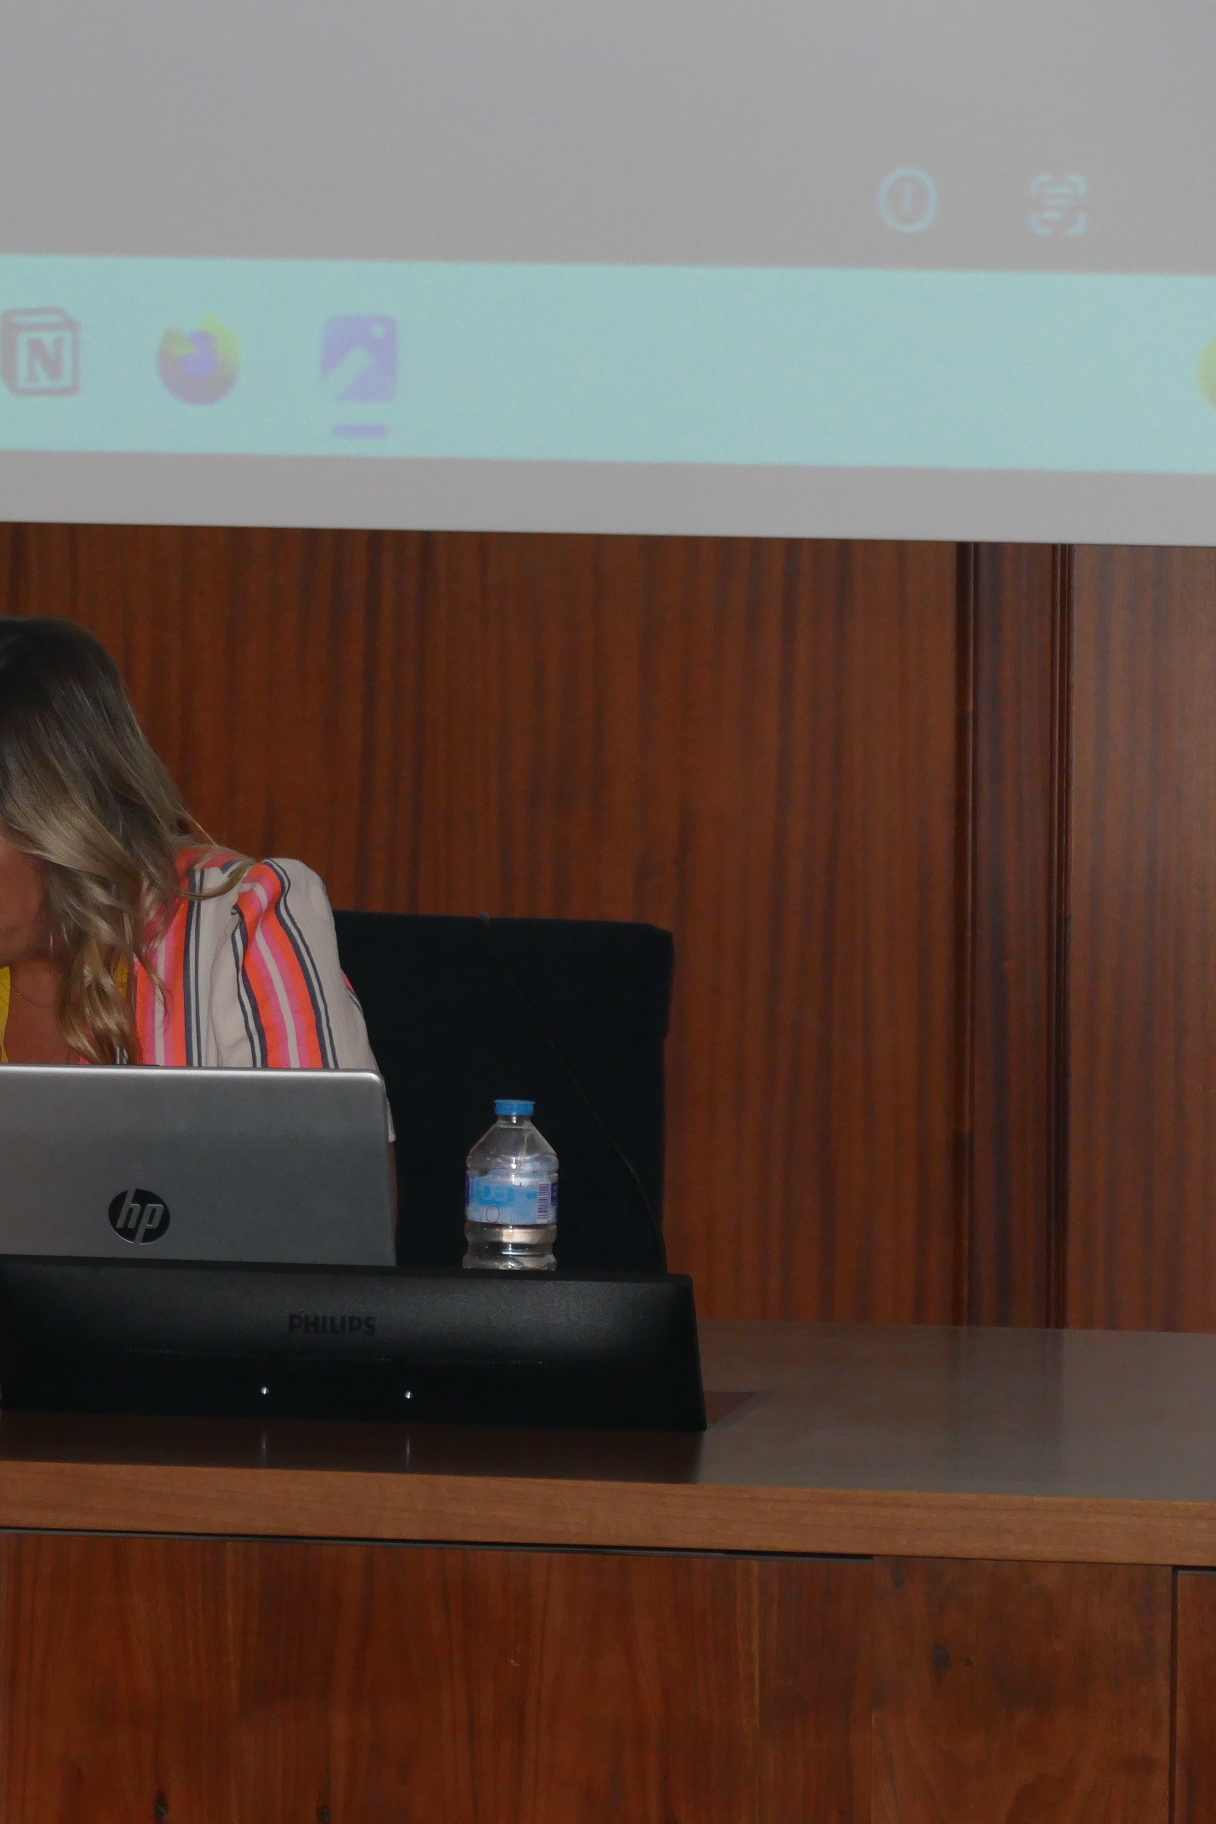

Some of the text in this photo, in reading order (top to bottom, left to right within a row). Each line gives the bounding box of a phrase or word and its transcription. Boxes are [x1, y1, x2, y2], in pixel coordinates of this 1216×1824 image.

[26, 337, 64, 383] N
[115, 1188, 164, 1244] hp
[287, 1313, 376, 1336] PHILIPS
